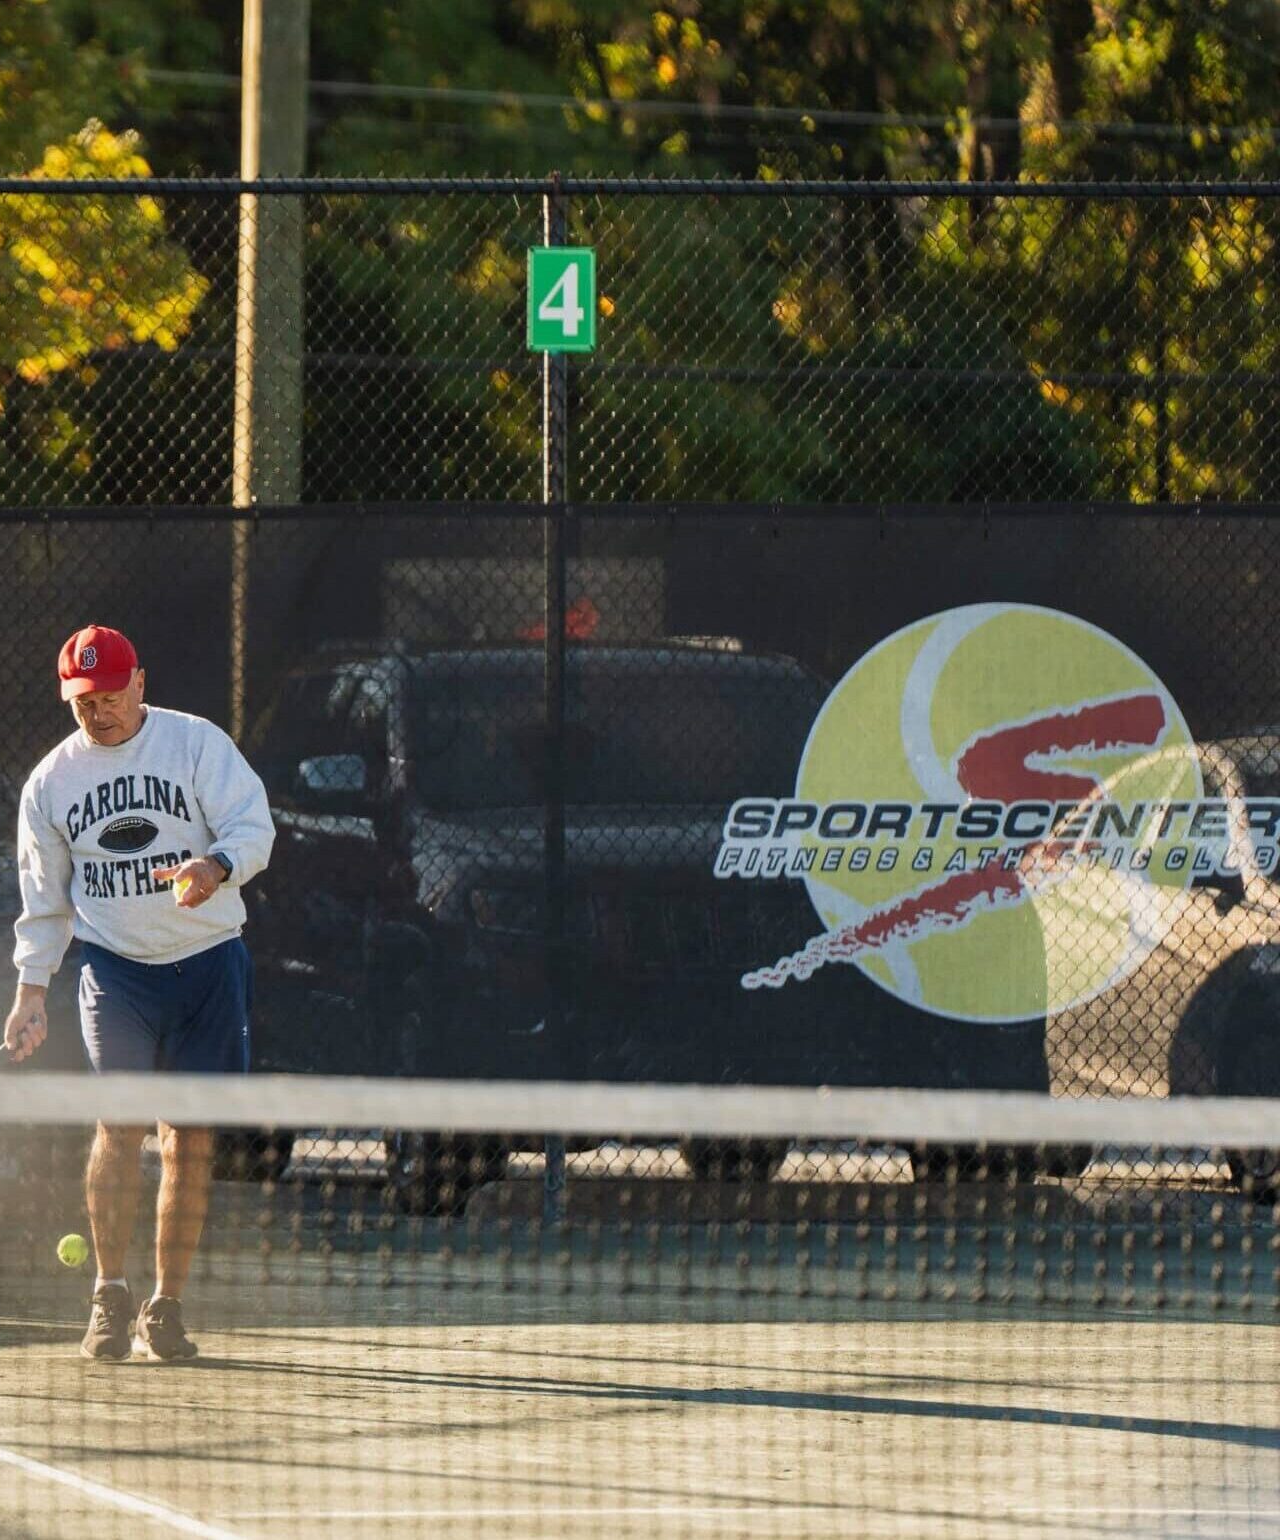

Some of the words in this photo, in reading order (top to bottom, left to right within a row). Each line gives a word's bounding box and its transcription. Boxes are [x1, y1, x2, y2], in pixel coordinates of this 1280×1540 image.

[538, 262, 584, 337] 4
[81, 646, 97, 670] B
[66, 774, 192, 843] CAROLINA
[727, 802, 1280, 840] SPORTSCENTER
[83, 849, 192, 898] PANTHE
[718, 847, 900, 872] FITNESS
[911, 847, 933, 872] &
[943, 845, 1152, 873] ATHETIC
